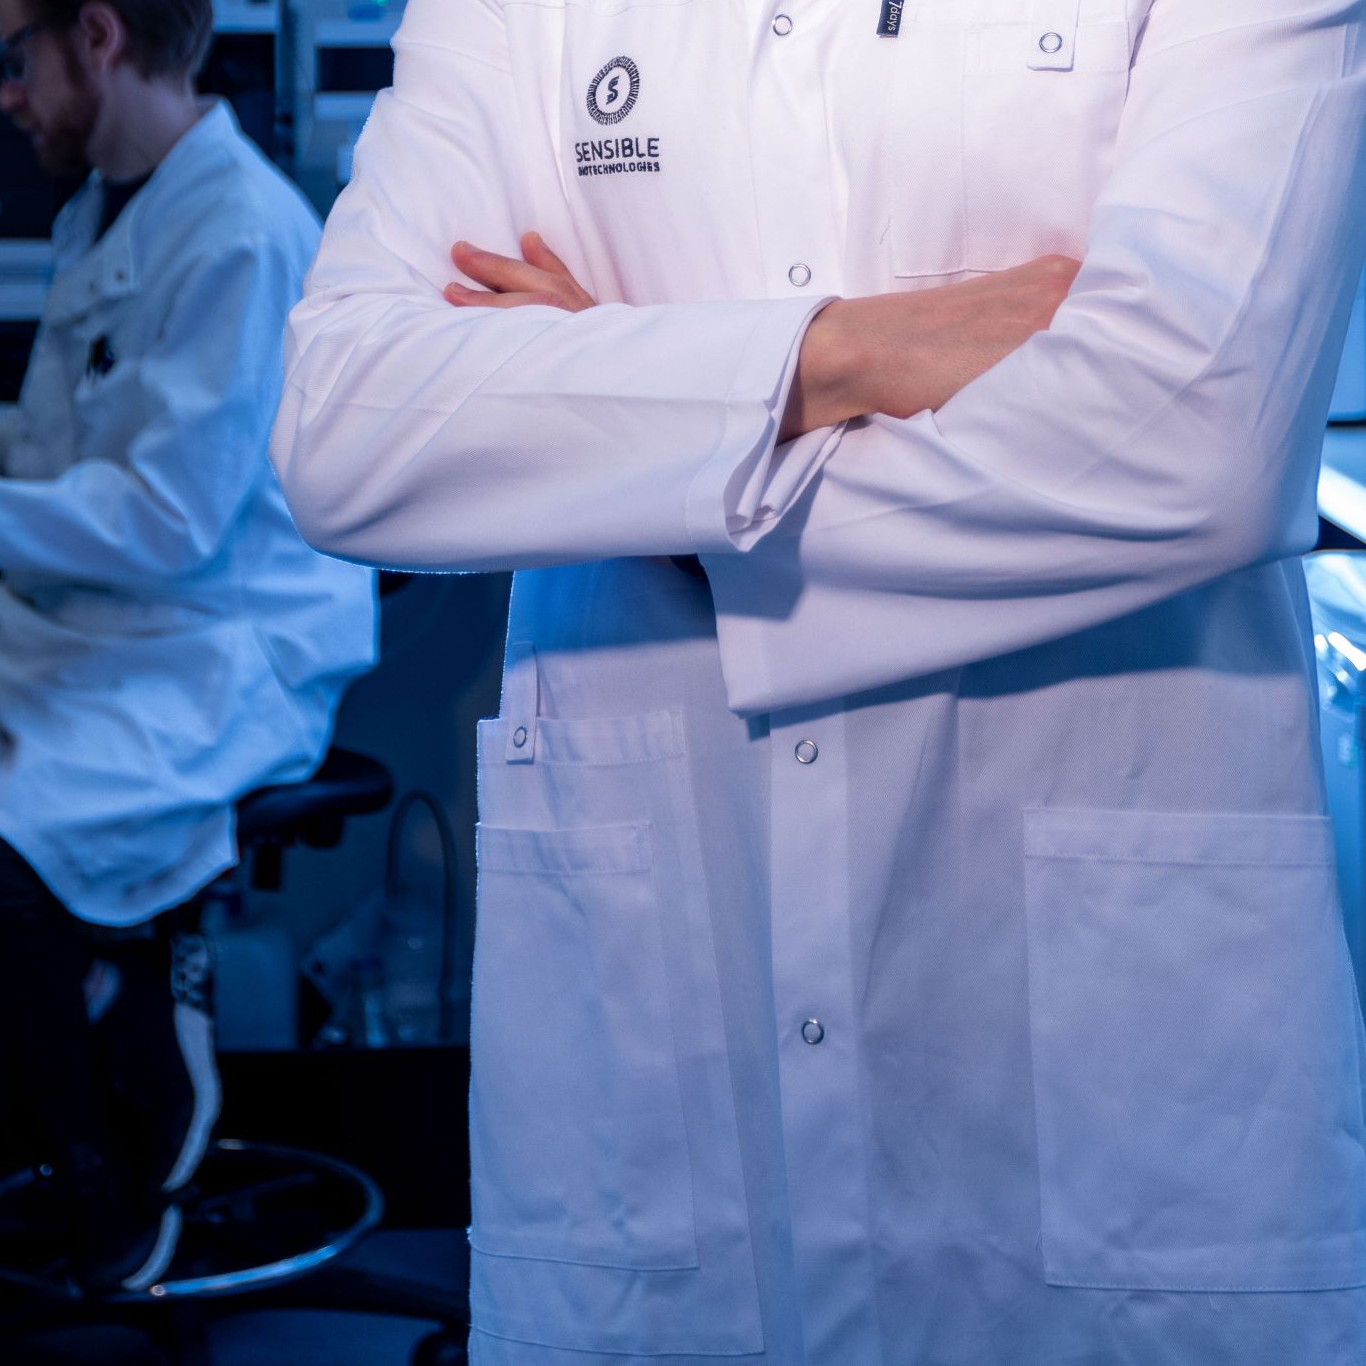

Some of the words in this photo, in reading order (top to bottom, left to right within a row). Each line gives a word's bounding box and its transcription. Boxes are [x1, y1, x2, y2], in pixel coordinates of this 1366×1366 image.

[886, 1, 903, 31] 7days
[575, 137, 660, 163] SENSIBLE
[578, 161, 660, 177] BIOTECHNOLOGIES
